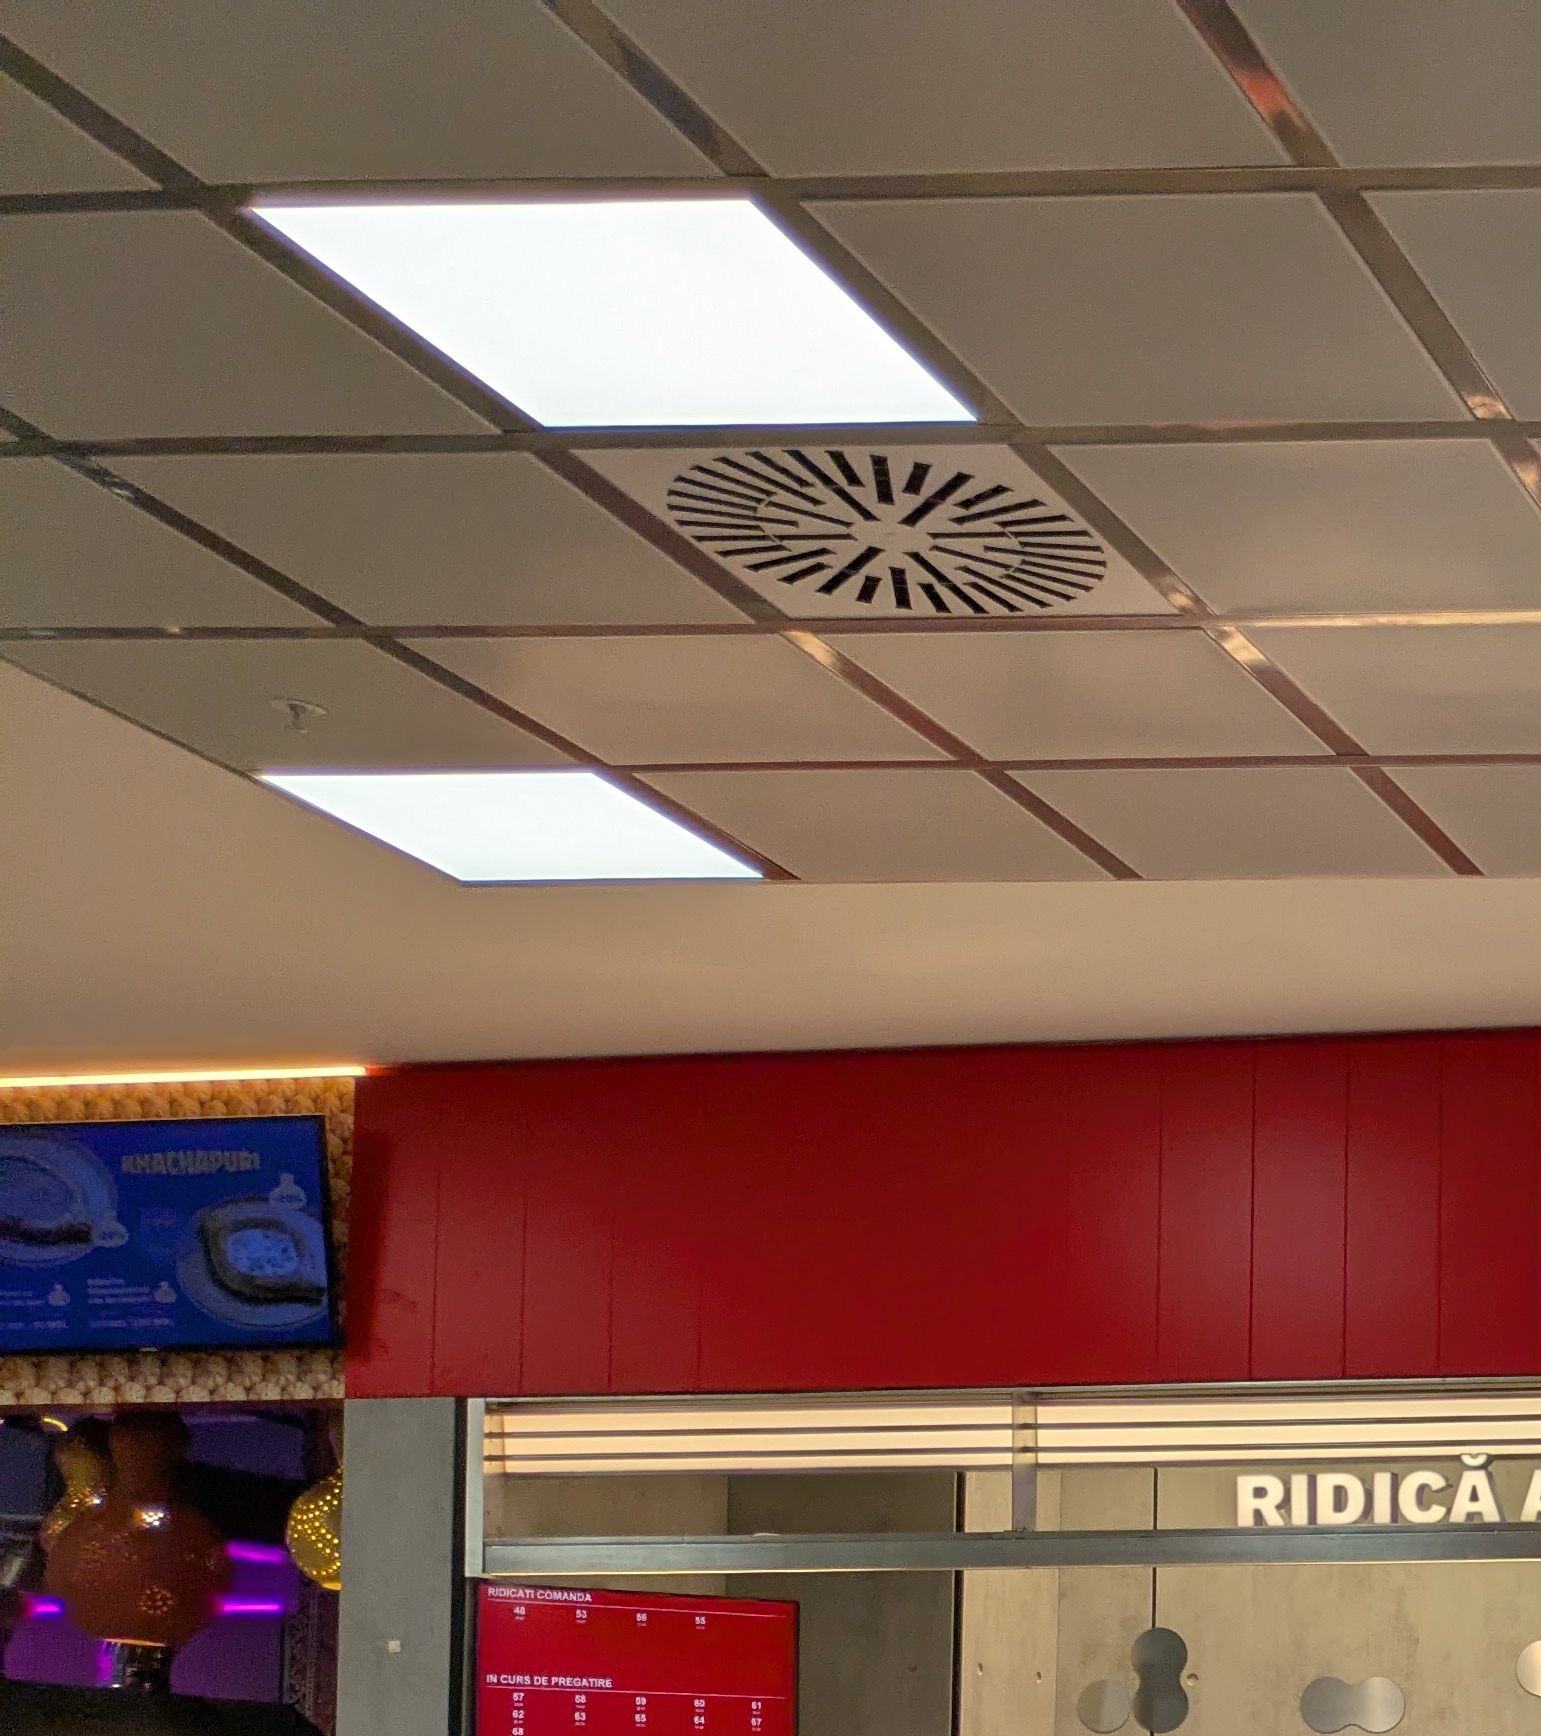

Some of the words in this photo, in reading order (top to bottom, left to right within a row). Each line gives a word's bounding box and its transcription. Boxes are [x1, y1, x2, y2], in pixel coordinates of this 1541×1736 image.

[1236, 1453, 1502, 1527] RIDICĂ
[537, 1591, 592, 1602] COMANDA
[500, 1675, 531, 1685] CURS
[534, 1676, 549, 1685] DE
[551, 1676, 613, 1688] PREGATIRE
